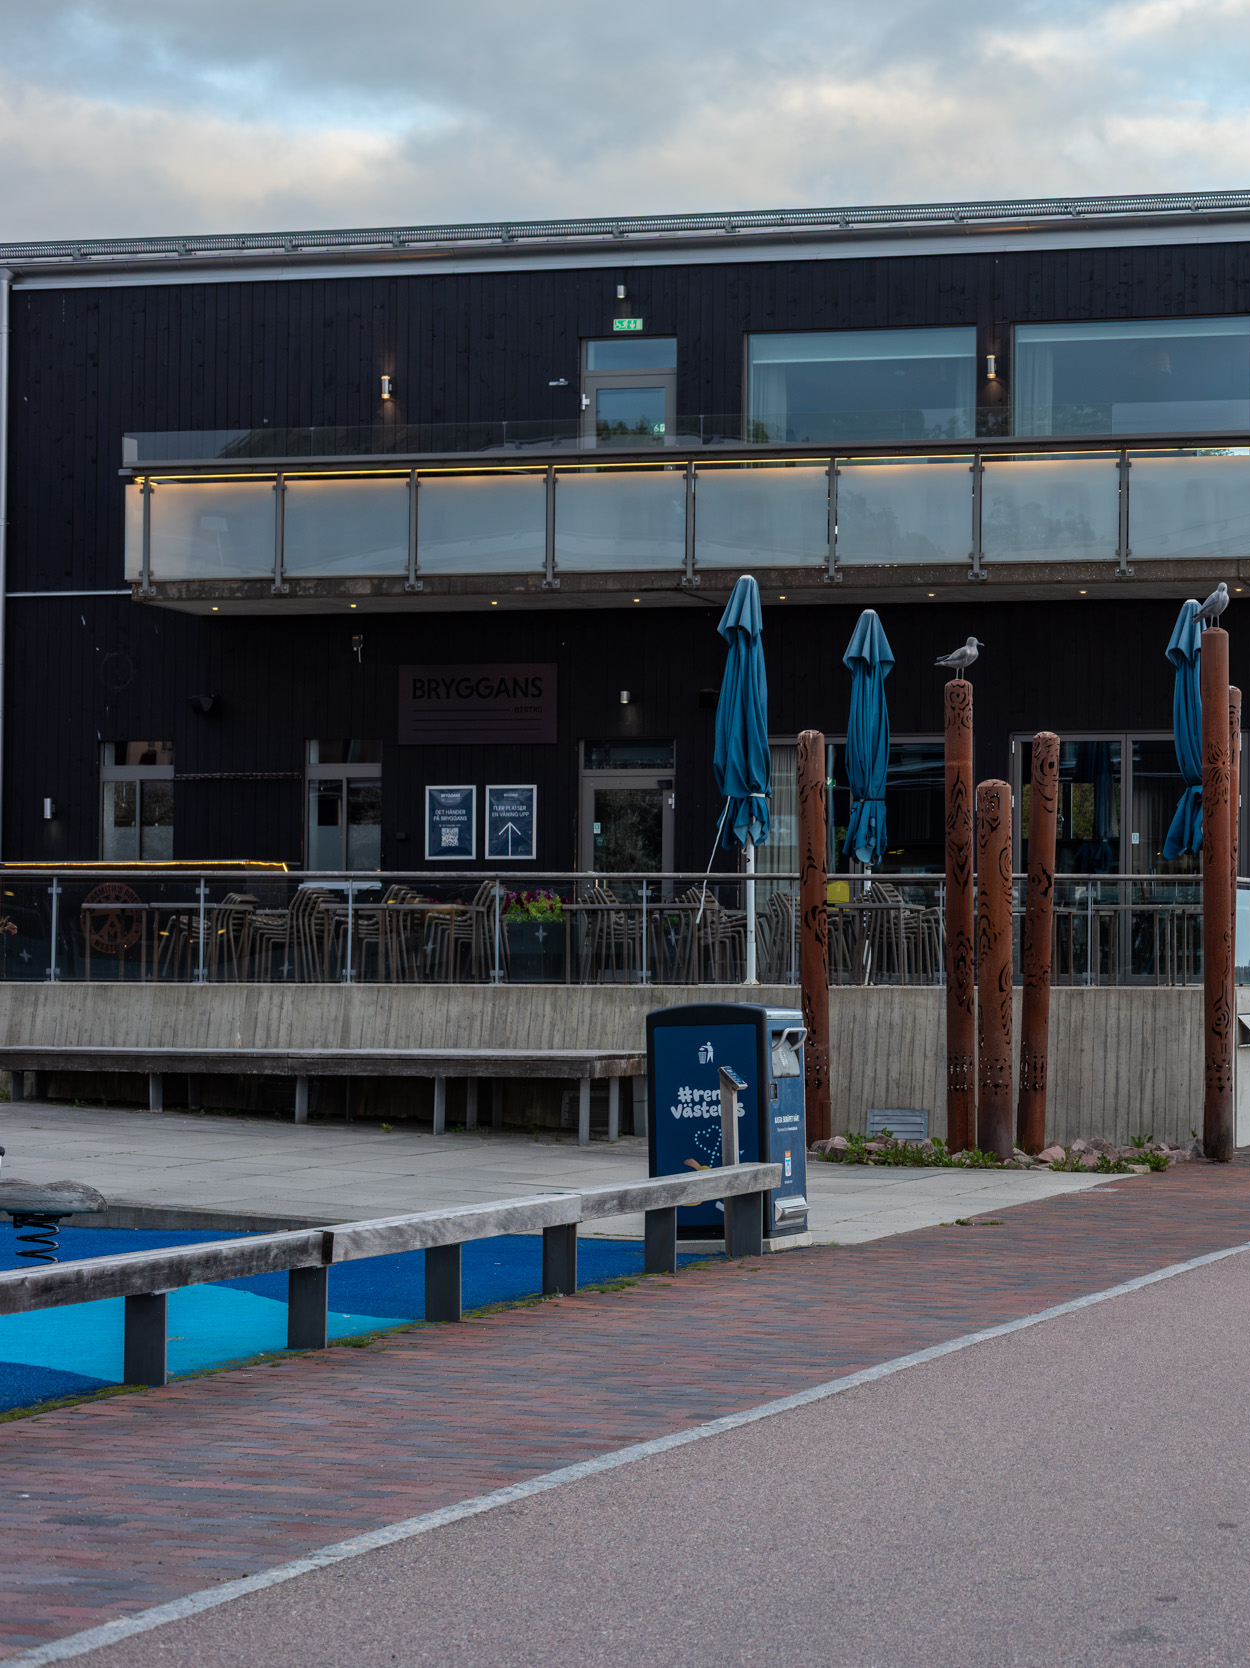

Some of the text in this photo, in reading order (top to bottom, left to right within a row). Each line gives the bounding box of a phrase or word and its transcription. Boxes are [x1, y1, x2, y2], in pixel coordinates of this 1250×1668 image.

[412, 677, 543, 700] BRYGGANS
[514, 706, 543, 714] BISTRO
[499, 810, 518, 818] VÅNING
